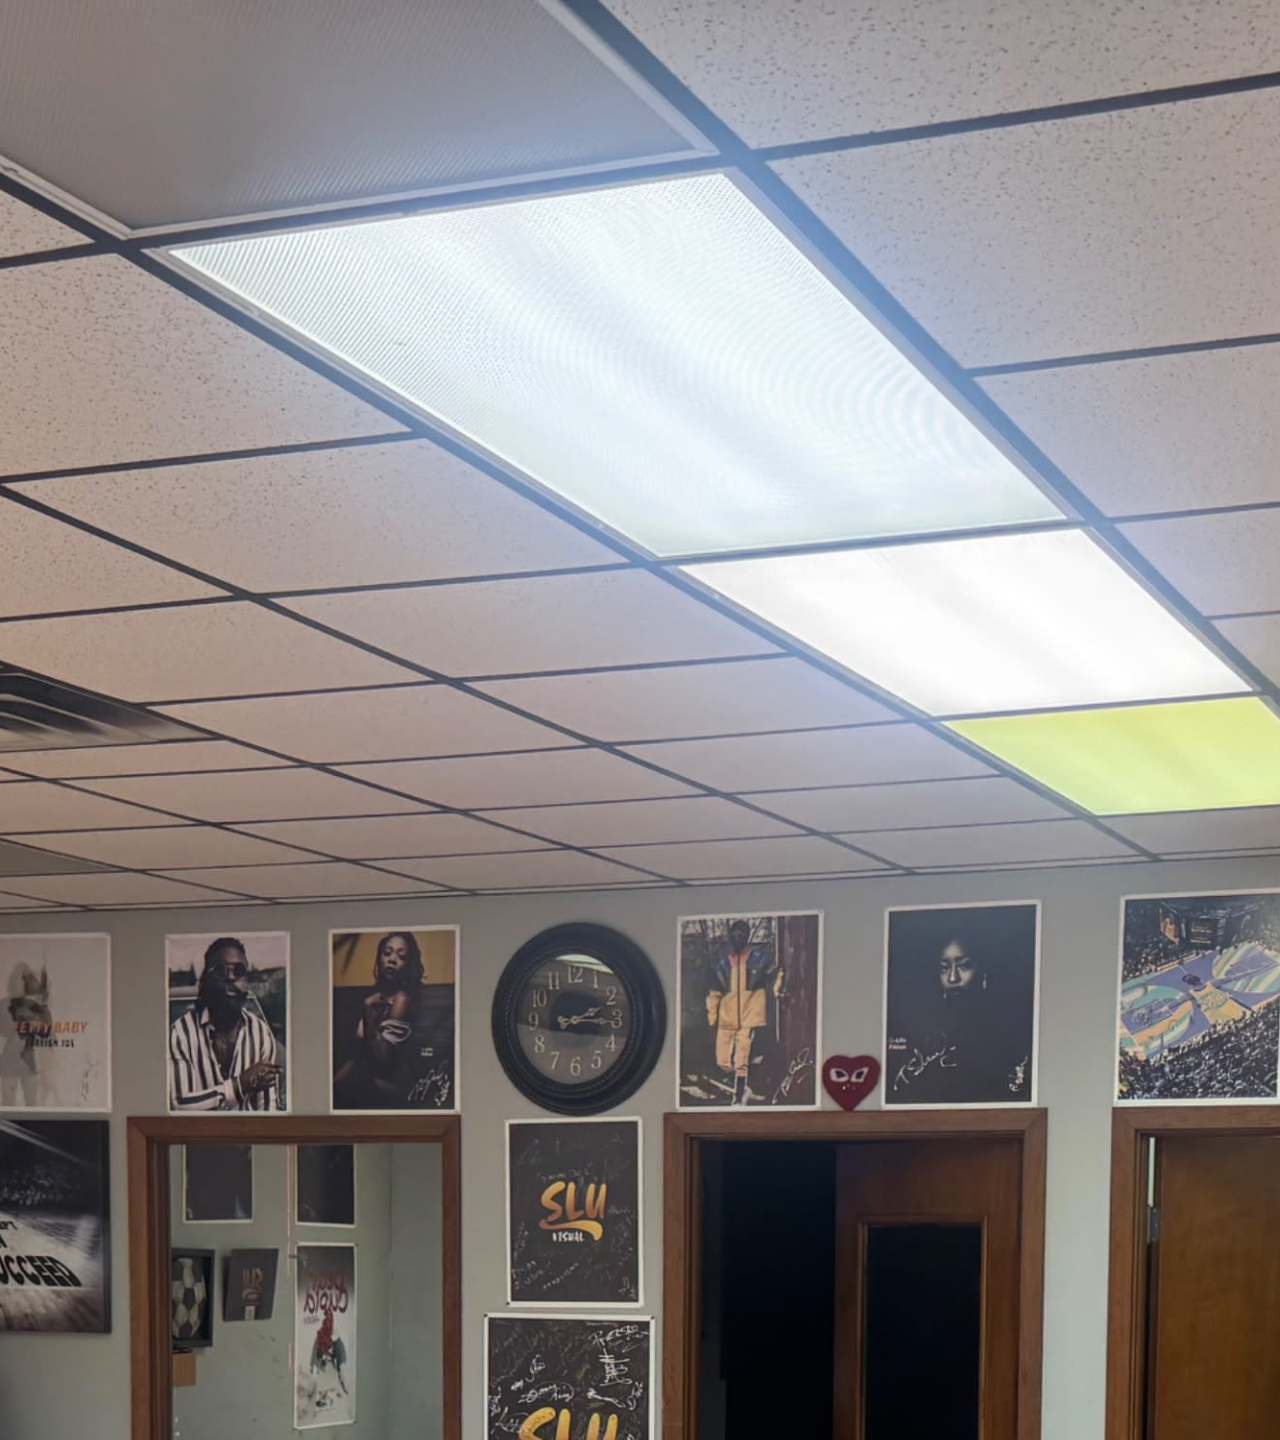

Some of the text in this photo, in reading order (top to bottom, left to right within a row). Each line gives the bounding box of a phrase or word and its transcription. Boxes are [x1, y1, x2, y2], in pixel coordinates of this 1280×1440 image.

[548, 972, 560, 990] 11
[568, 966, 583, 983] 12
[533, 990, 547, 1008] 10
[606, 986, 616, 1005] 2
[528, 1013, 539, 1030] 9
[611, 1010, 622, 1028] 3
[535, 1035, 545, 1052] 8
[605, 1033, 616, 1052] 4
[550, 1052, 560, 1069] 7
[571, 1057, 581, 1076] 6
[591, 1051, 602, 1069] 5
[541, 1181, 607, 1222] SLU
